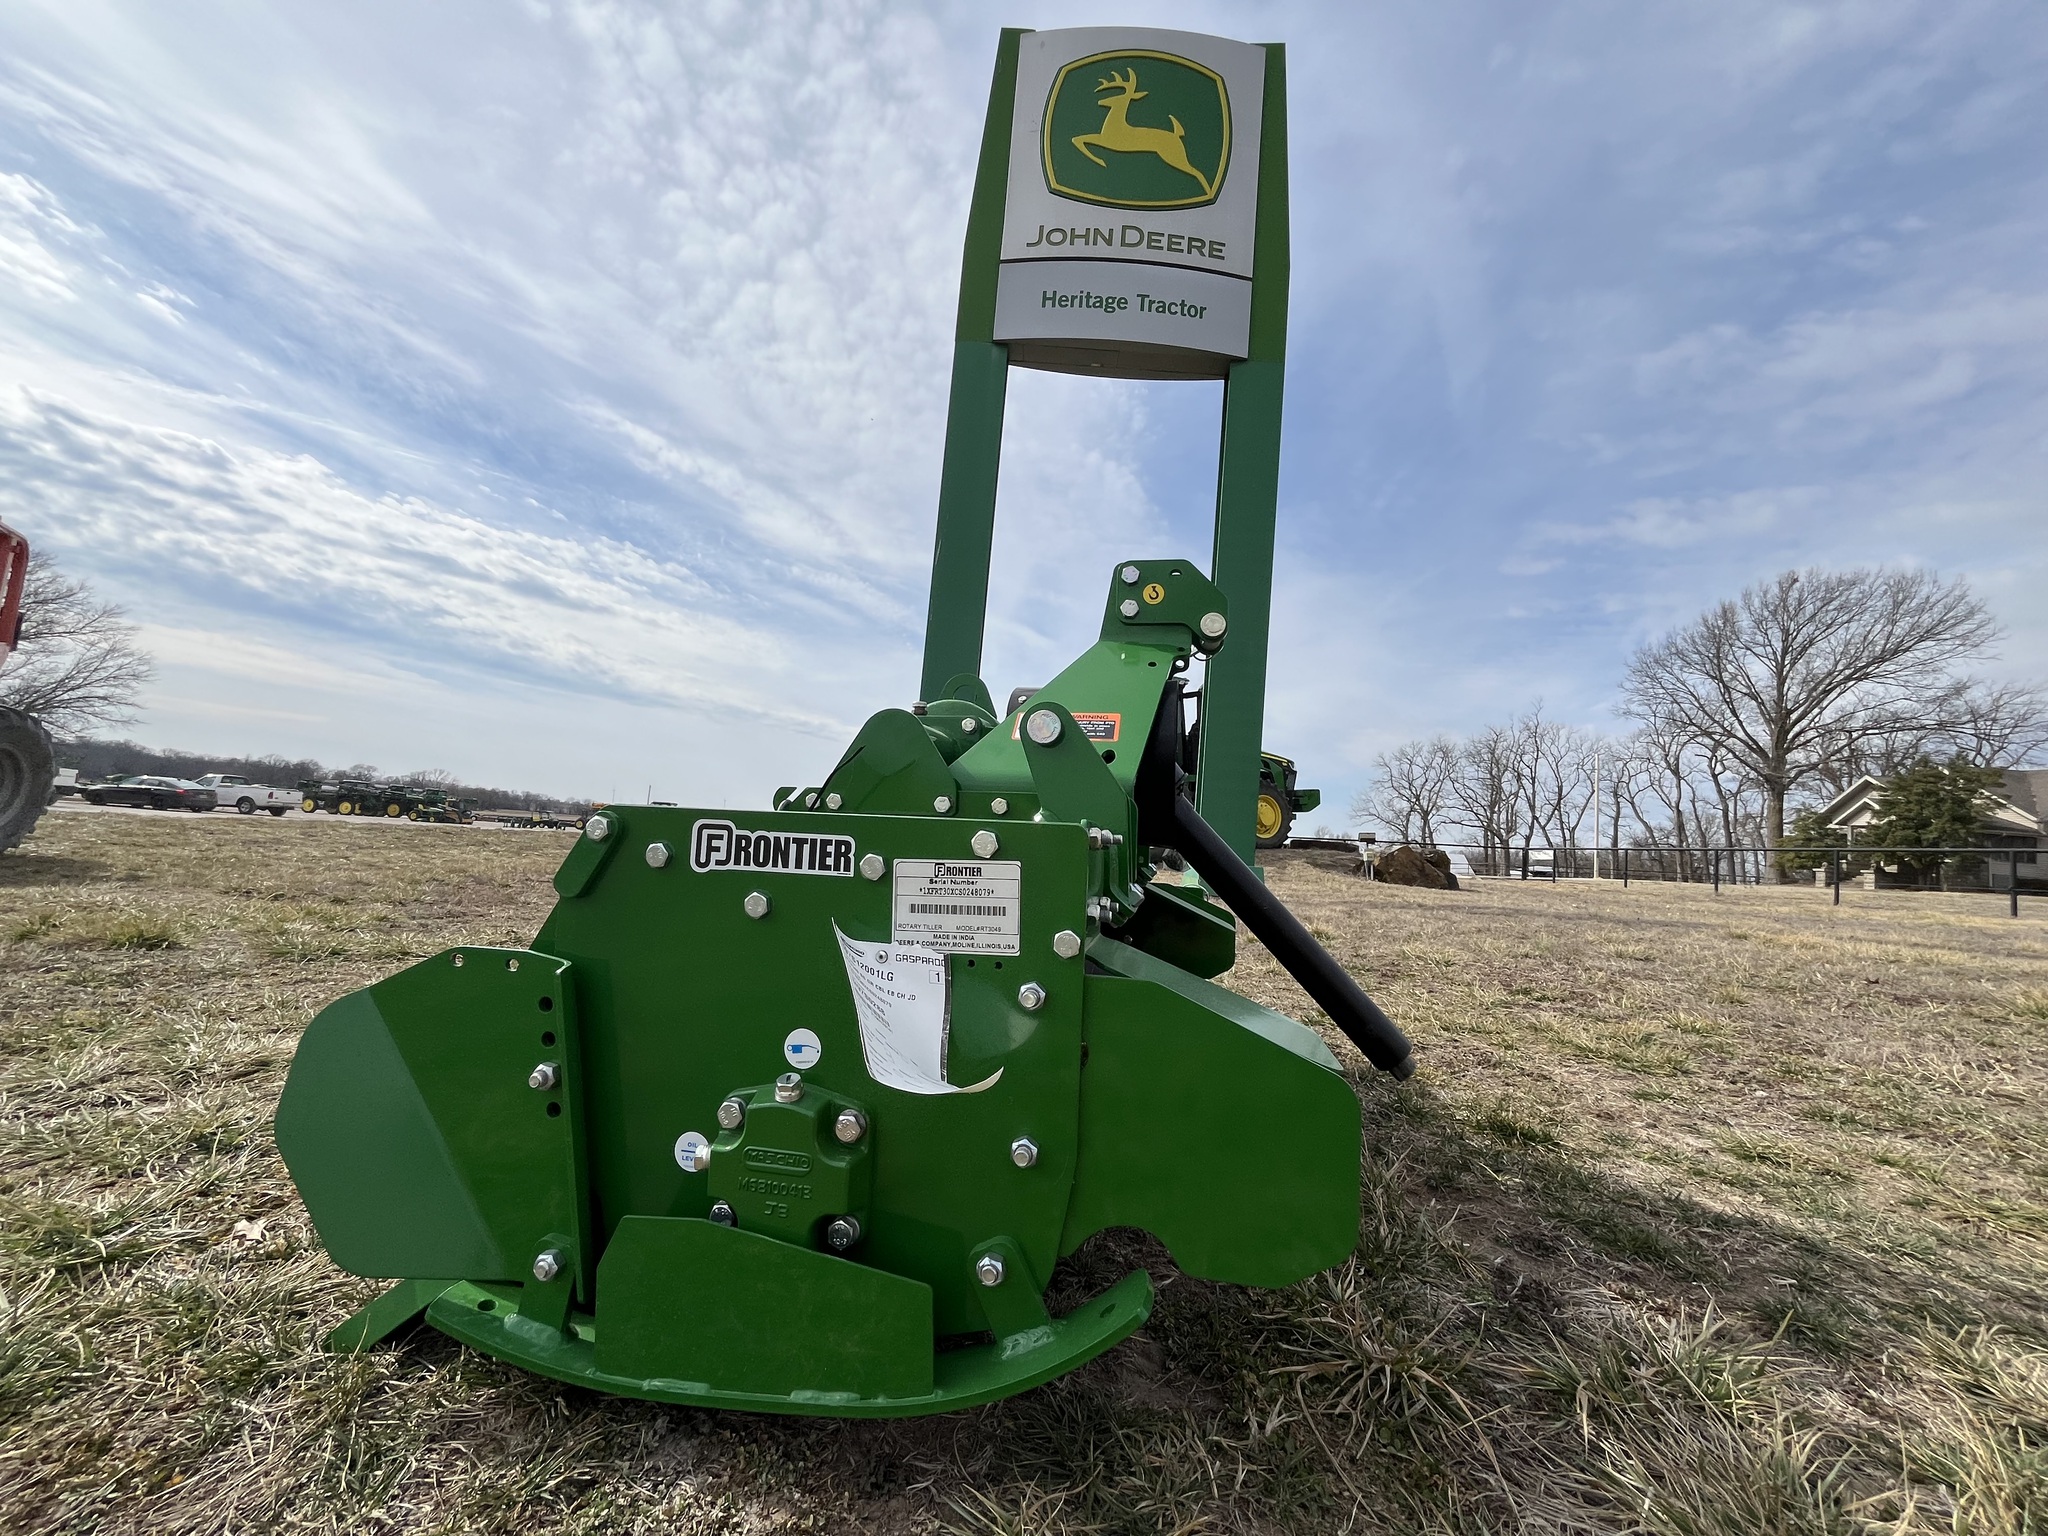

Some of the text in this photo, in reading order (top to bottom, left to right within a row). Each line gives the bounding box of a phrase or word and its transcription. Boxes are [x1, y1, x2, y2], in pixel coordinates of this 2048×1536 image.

[1026, 224, 1226, 260] JOHN DEERE
[1041, 290, 1207, 319] Heritage Tractor
[695, 823, 852, 873] FRONTIER
[934, 863, 982, 877] FRONTIER
[935, 972, 941, 983] 1
[687, 1141, 698, 1149] OIL
